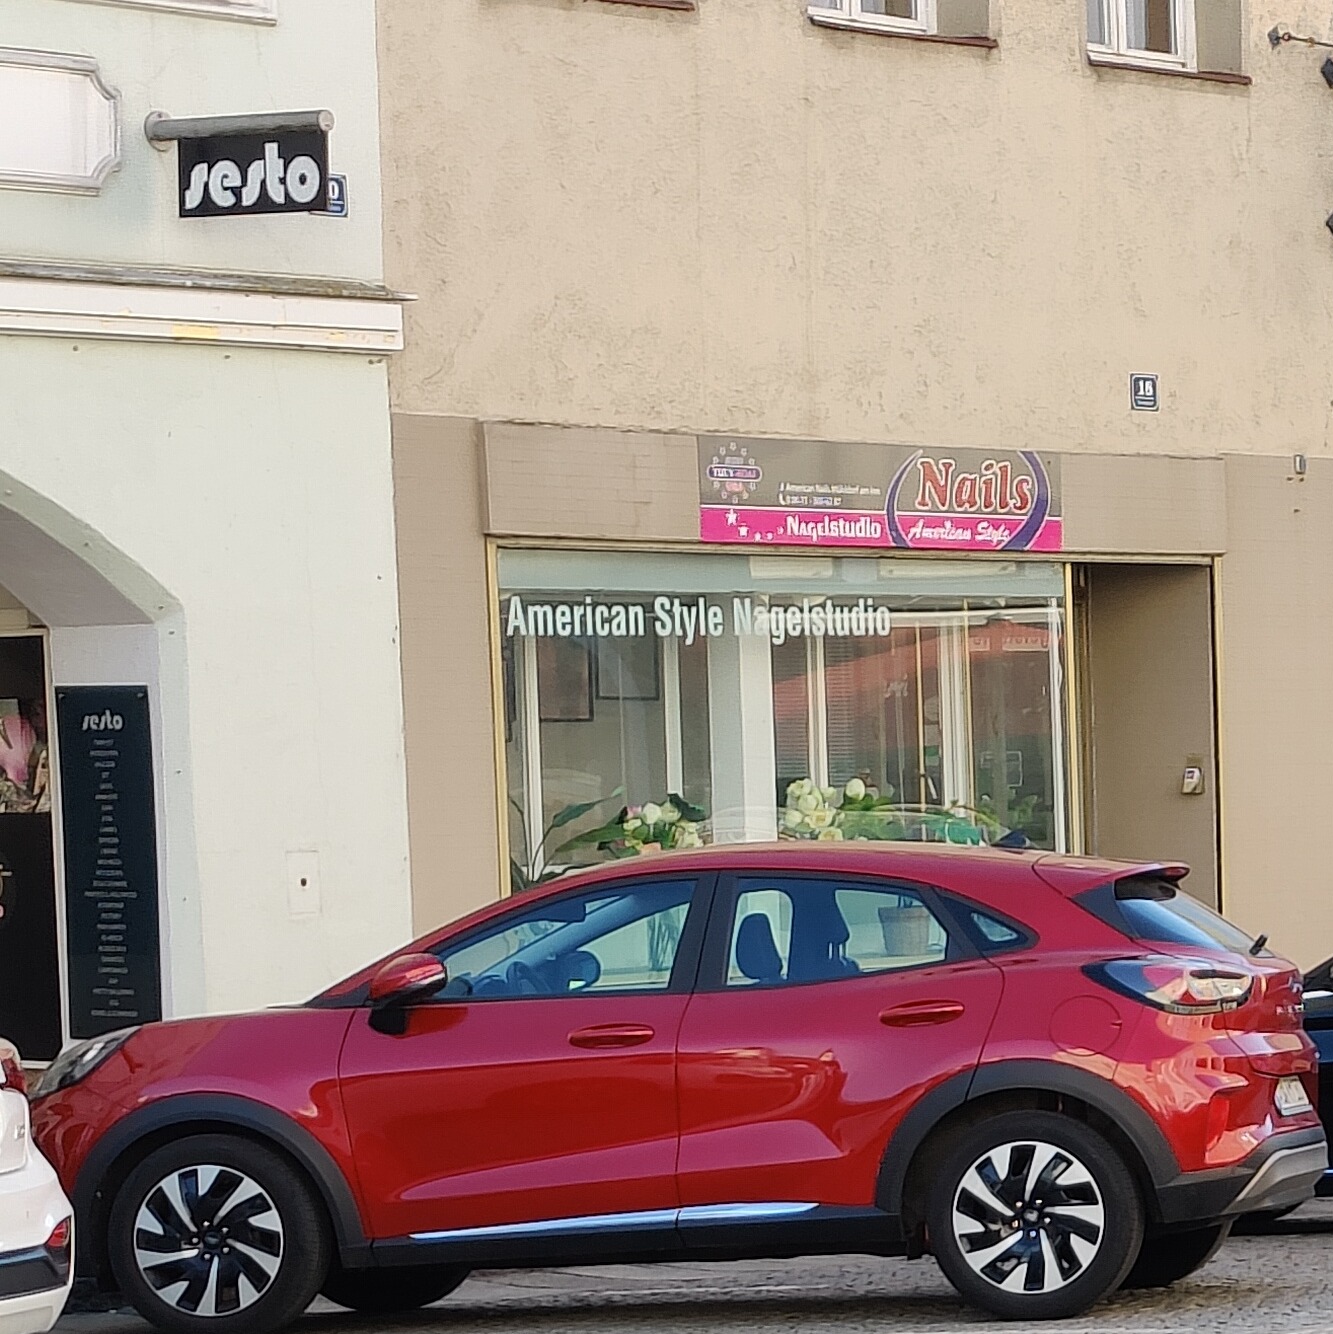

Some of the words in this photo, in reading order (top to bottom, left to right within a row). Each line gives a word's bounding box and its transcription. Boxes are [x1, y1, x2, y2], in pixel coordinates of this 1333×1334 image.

[184, 141, 321, 211] sesto
[915, 458, 1033, 515] Nails
[505, 595, 645, 637] American
[653, 595, 724, 646] Style
[733, 596, 892, 645] Nagelstudio
